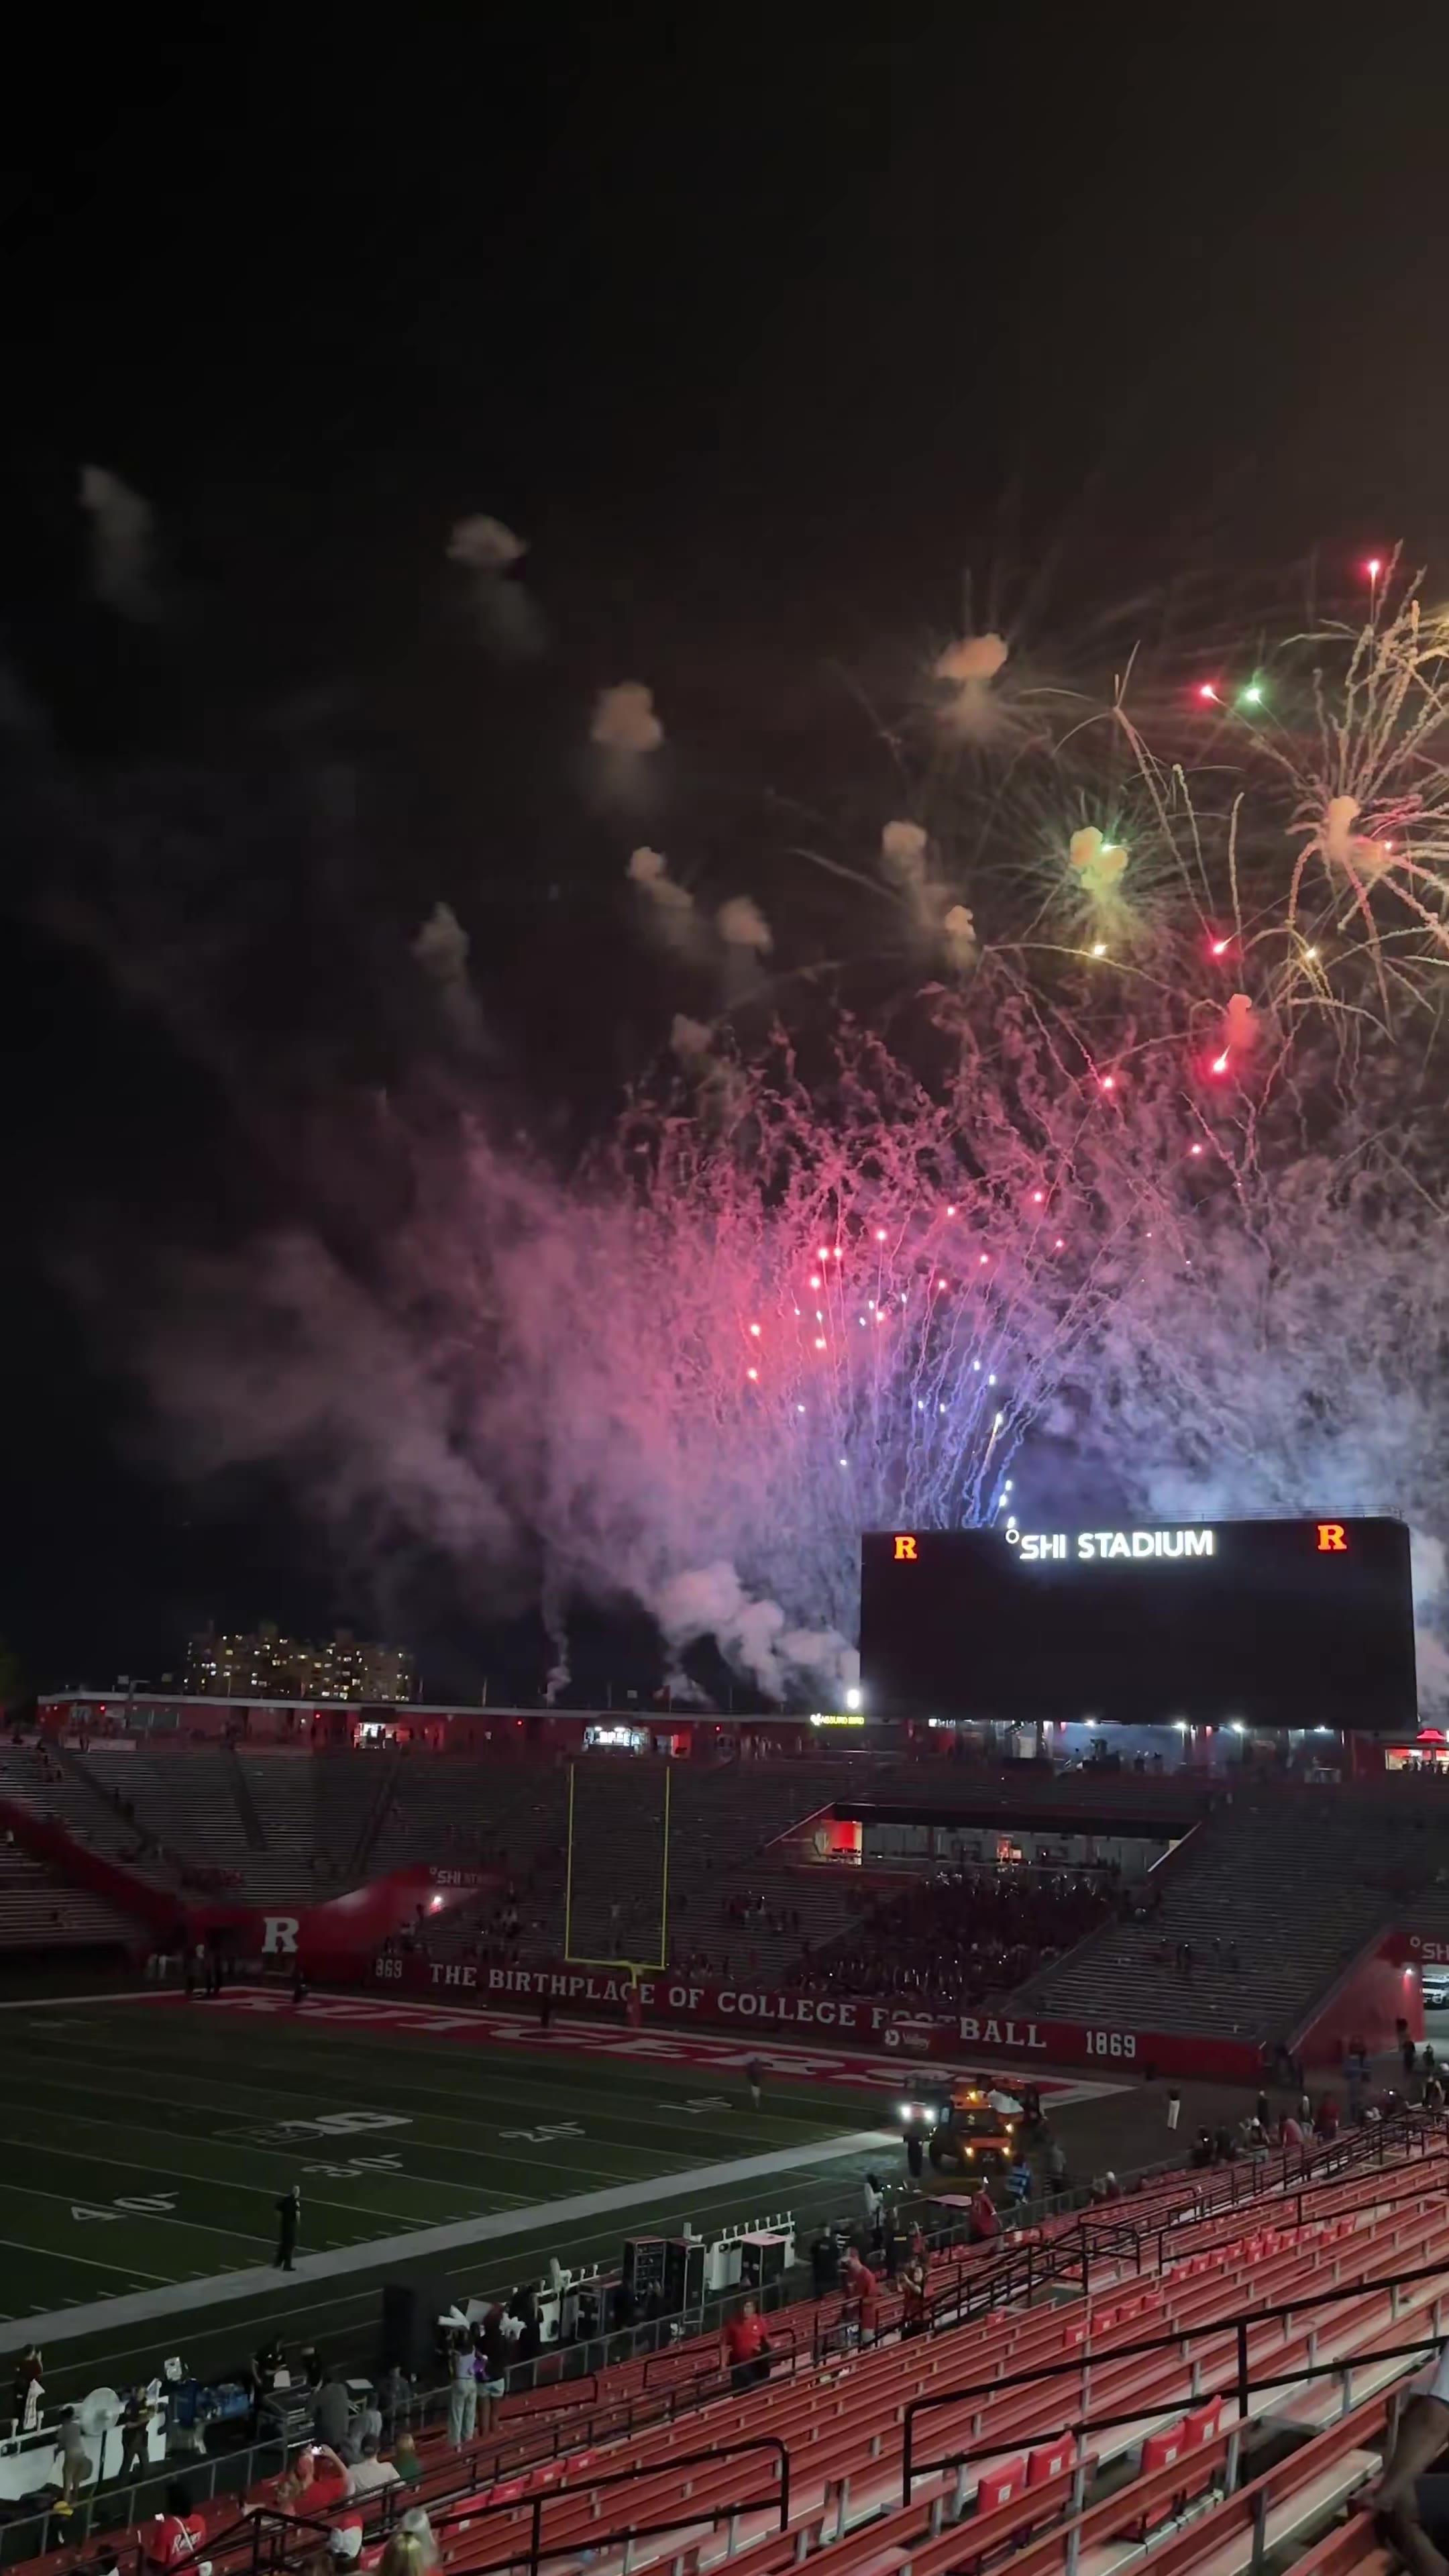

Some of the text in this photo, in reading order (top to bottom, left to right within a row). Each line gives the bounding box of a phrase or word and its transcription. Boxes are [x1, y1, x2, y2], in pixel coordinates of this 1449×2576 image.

[894, 1536, 918, 1559] R
[1020, 1530, 1214, 1559] SHI STADIUM
[1317, 1524, 1347, 1550] R
[435, 1870, 461, 1884] SHI
[261, 1917, 300, 1953] R
[374, 1957, 402, 1978] 869
[429, 1963, 478, 1987] THE
[488, 1968, 655, 2004] BIRTHPLACE
[669, 1986, 705, 2009] OF
[717, 1991, 857, 2027] COLLEGE
[1085, 2030, 1136, 2058] 1869
[498, 2125, 586, 2142] 20
[301, 2157, 403, 2178] 30
[71, 2197, 176, 2221] 40
